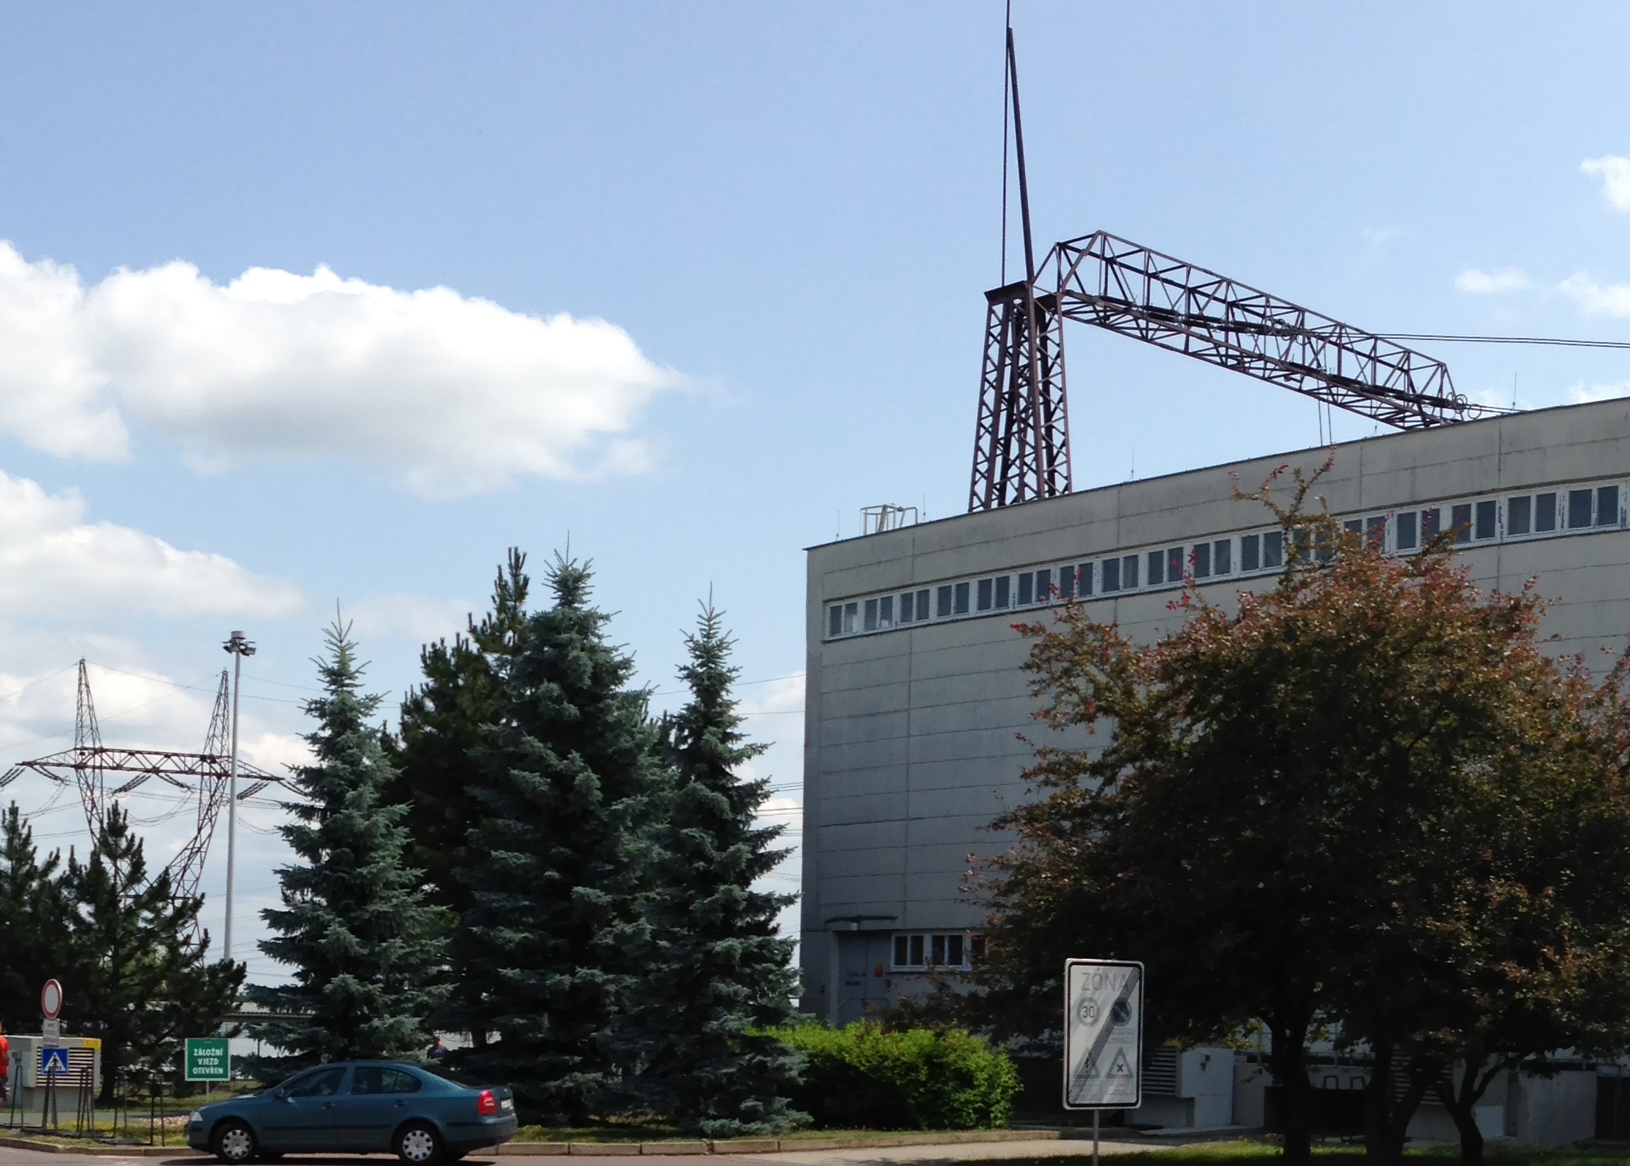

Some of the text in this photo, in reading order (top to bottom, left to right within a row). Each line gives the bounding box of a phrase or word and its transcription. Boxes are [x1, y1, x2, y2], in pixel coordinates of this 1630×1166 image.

[1081, 967, 1131, 992] ZÓNA
[1081, 1004, 1096, 1019] 30
[193, 1047, 224, 1056] ZÁLOŽNÍ
[197, 1058, 219, 1066] VJEZD
[192, 1066, 224, 1075] OTEVŘEN
